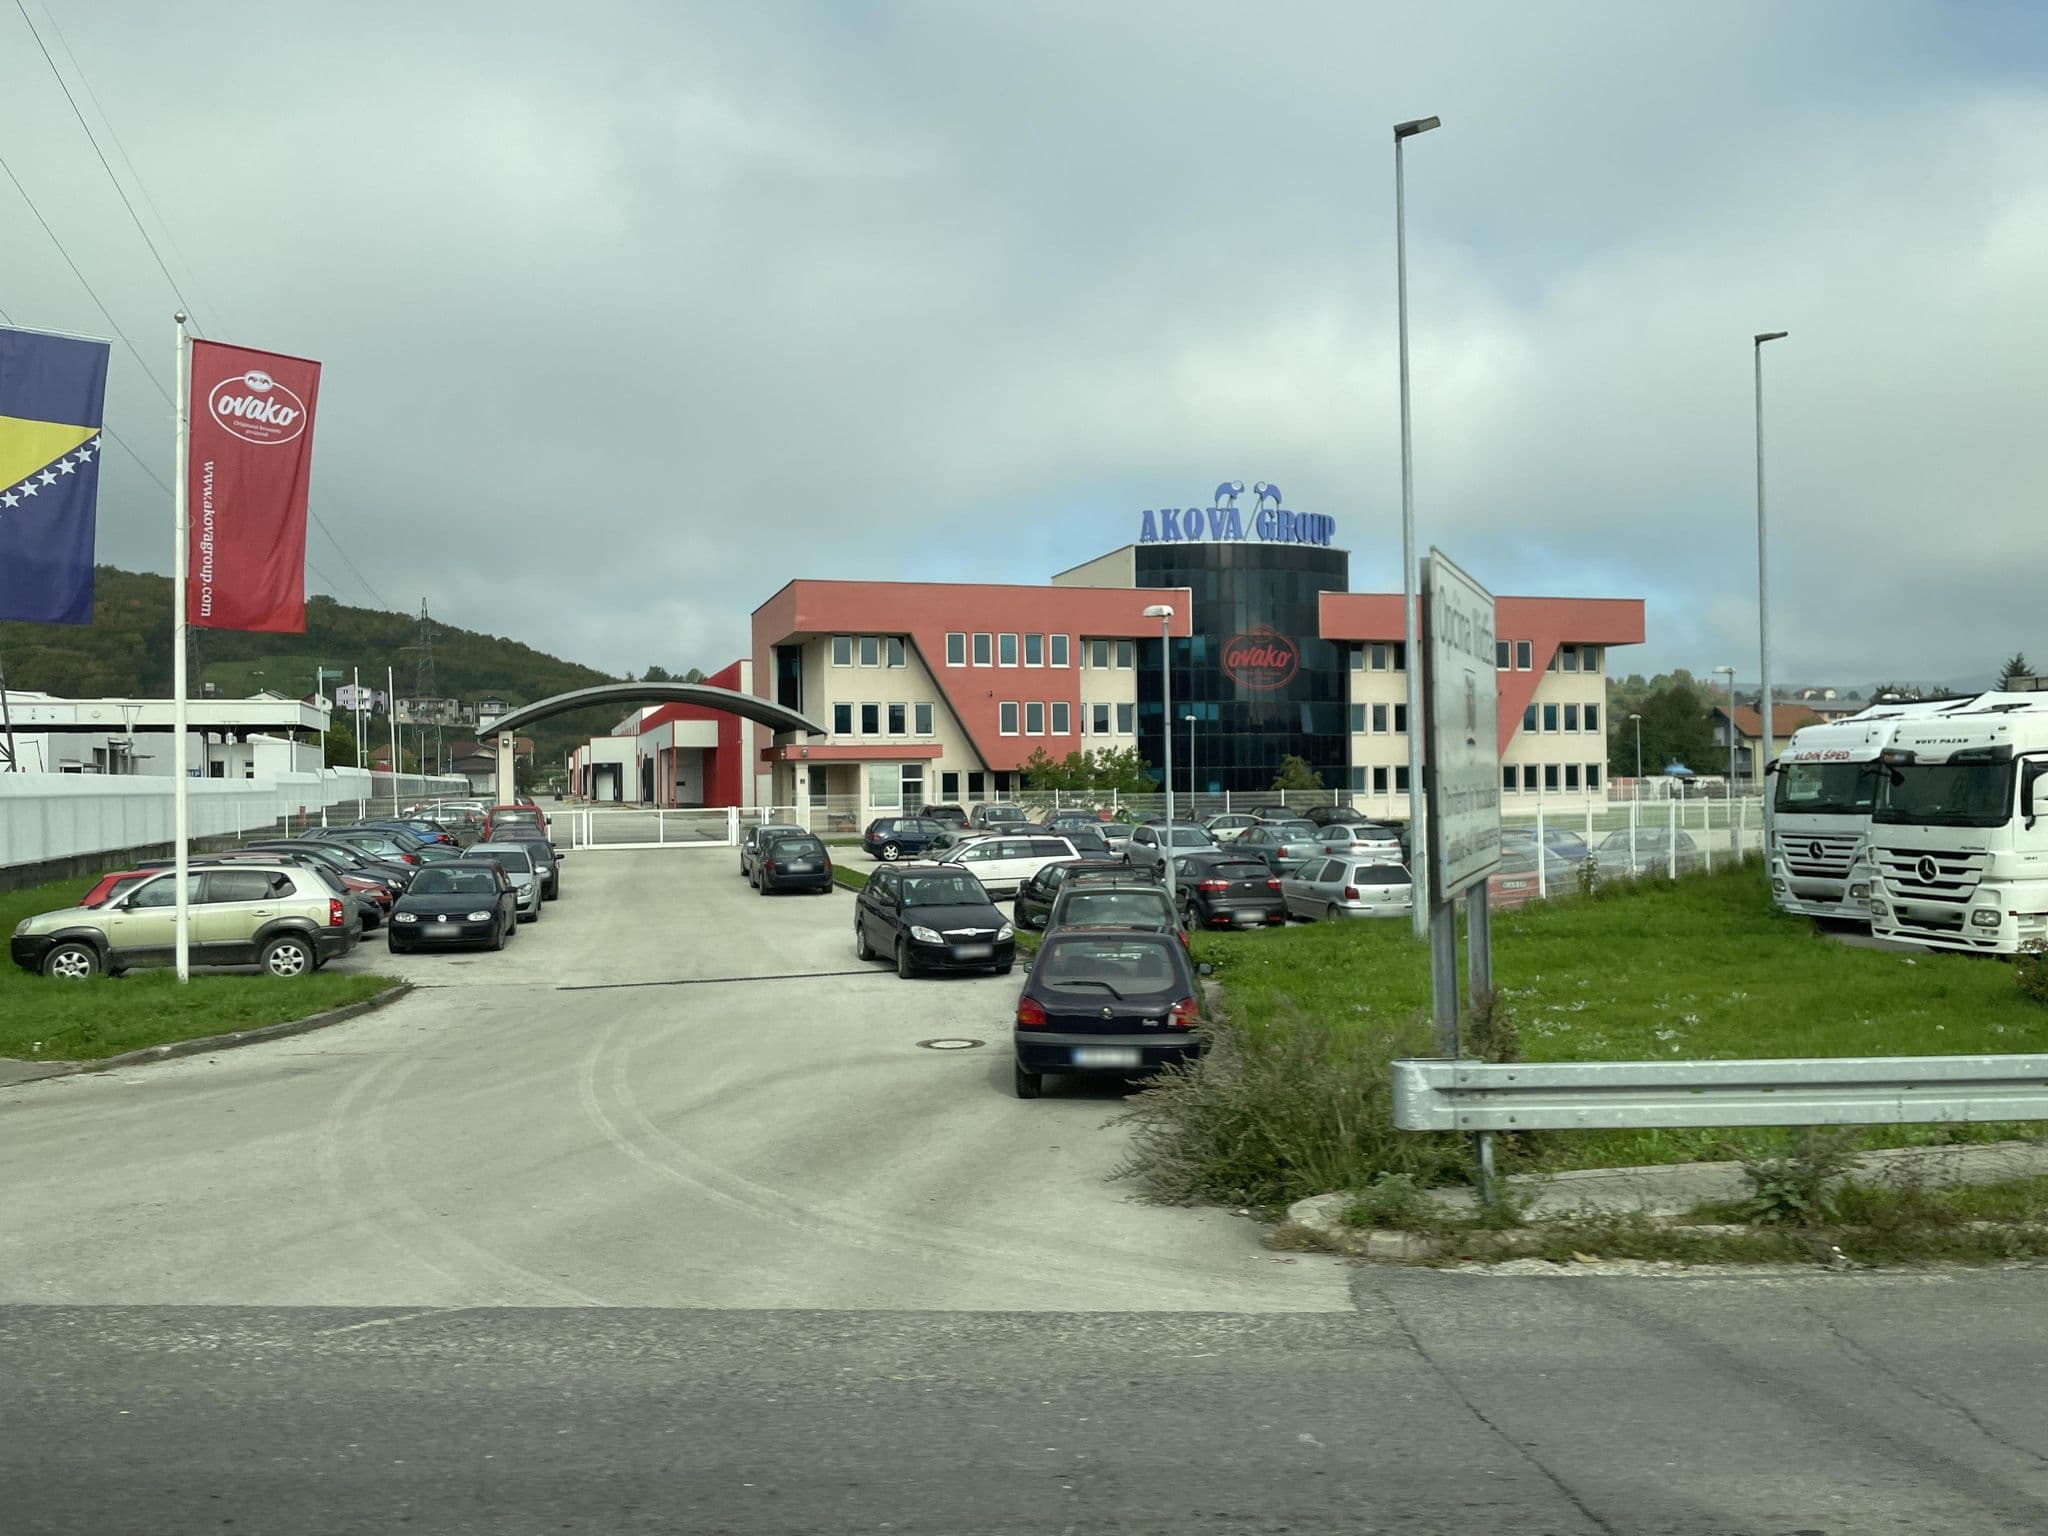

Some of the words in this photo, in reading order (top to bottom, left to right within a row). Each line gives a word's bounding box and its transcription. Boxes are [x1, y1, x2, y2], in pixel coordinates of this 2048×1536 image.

[218, 395, 300, 426] ovako
[200, 461, 215, 617] www.akovagroup.com
[1139, 508, 1243, 542] AKOVA
[1256, 509, 1336, 546] GROUP
[1228, 644, 1292, 668] ovako
